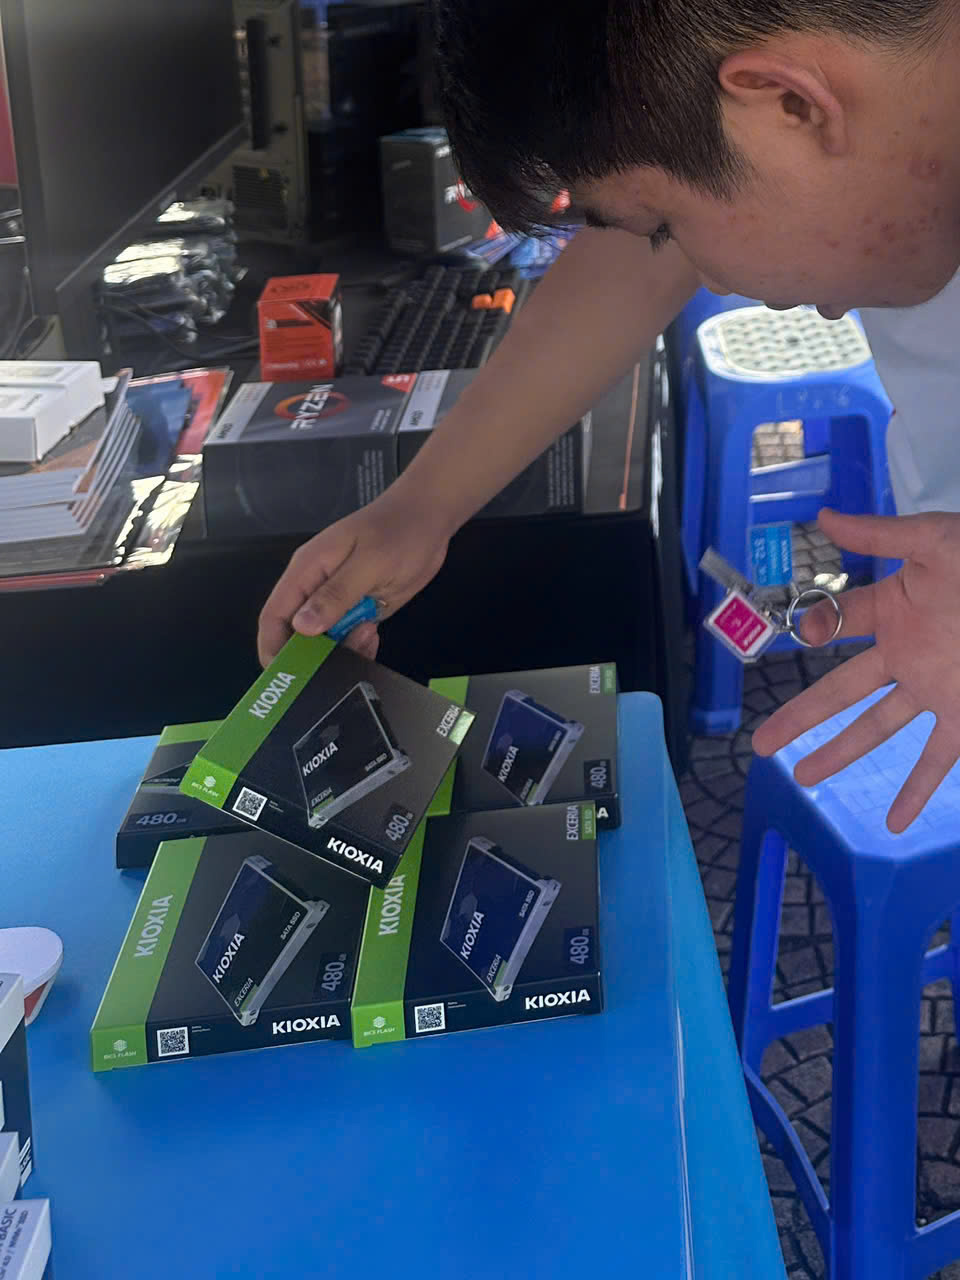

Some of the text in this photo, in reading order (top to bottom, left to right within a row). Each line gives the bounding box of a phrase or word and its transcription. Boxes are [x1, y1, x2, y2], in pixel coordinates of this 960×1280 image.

[290, 382, 334, 431] RYZEN
[249, 671, 296, 719] KIOXIA
[302, 741, 339, 777] KIOXIA
[498, 745, 520, 783] KIOXIA
[591, 766, 607, 789] 480
[136, 812, 179, 826] 480
[385, 814, 410, 841] 480
[326, 836, 385, 874] KIOXIA
[378, 874, 406, 936] KIOXIA
[133, 893, 173, 958] KIOXIA
[460, 910, 485, 960] KIOXIA
[212, 932, 245, 984] KIOXIA
[569, 934, 590, 965] 480
[321, 961, 346, 992] 480
[525, 988, 591, 1010] KIOXIA
[272, 1014, 341, 1035] KIOXIA
